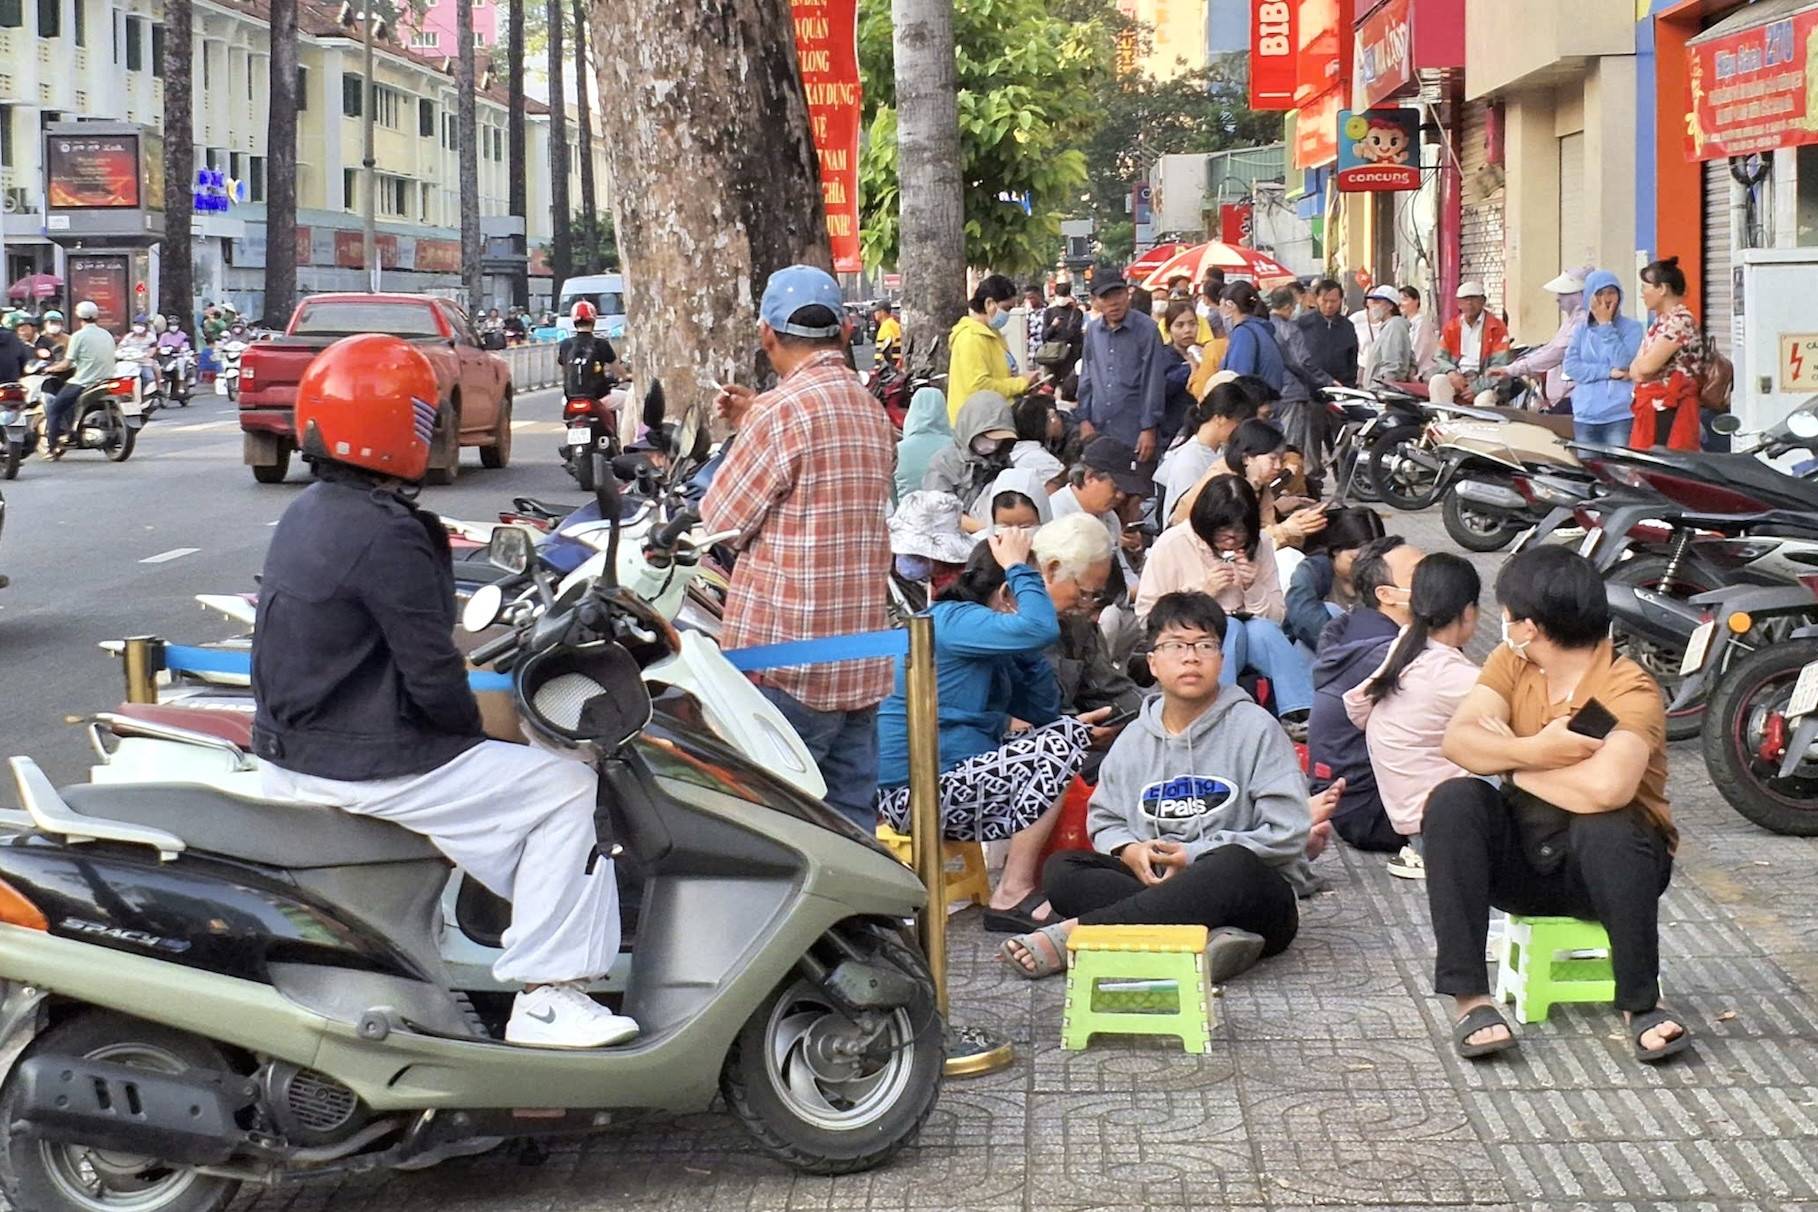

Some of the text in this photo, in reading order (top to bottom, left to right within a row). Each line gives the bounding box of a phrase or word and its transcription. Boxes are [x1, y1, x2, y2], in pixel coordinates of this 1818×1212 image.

[1259, 0, 1290, 56] BIB
[802, 43, 830, 72] LÒNG
[825, 79, 855, 111] DỰNG
[824, 149, 847, 170] NAM
[1160, 796, 1207, 818] Pals
